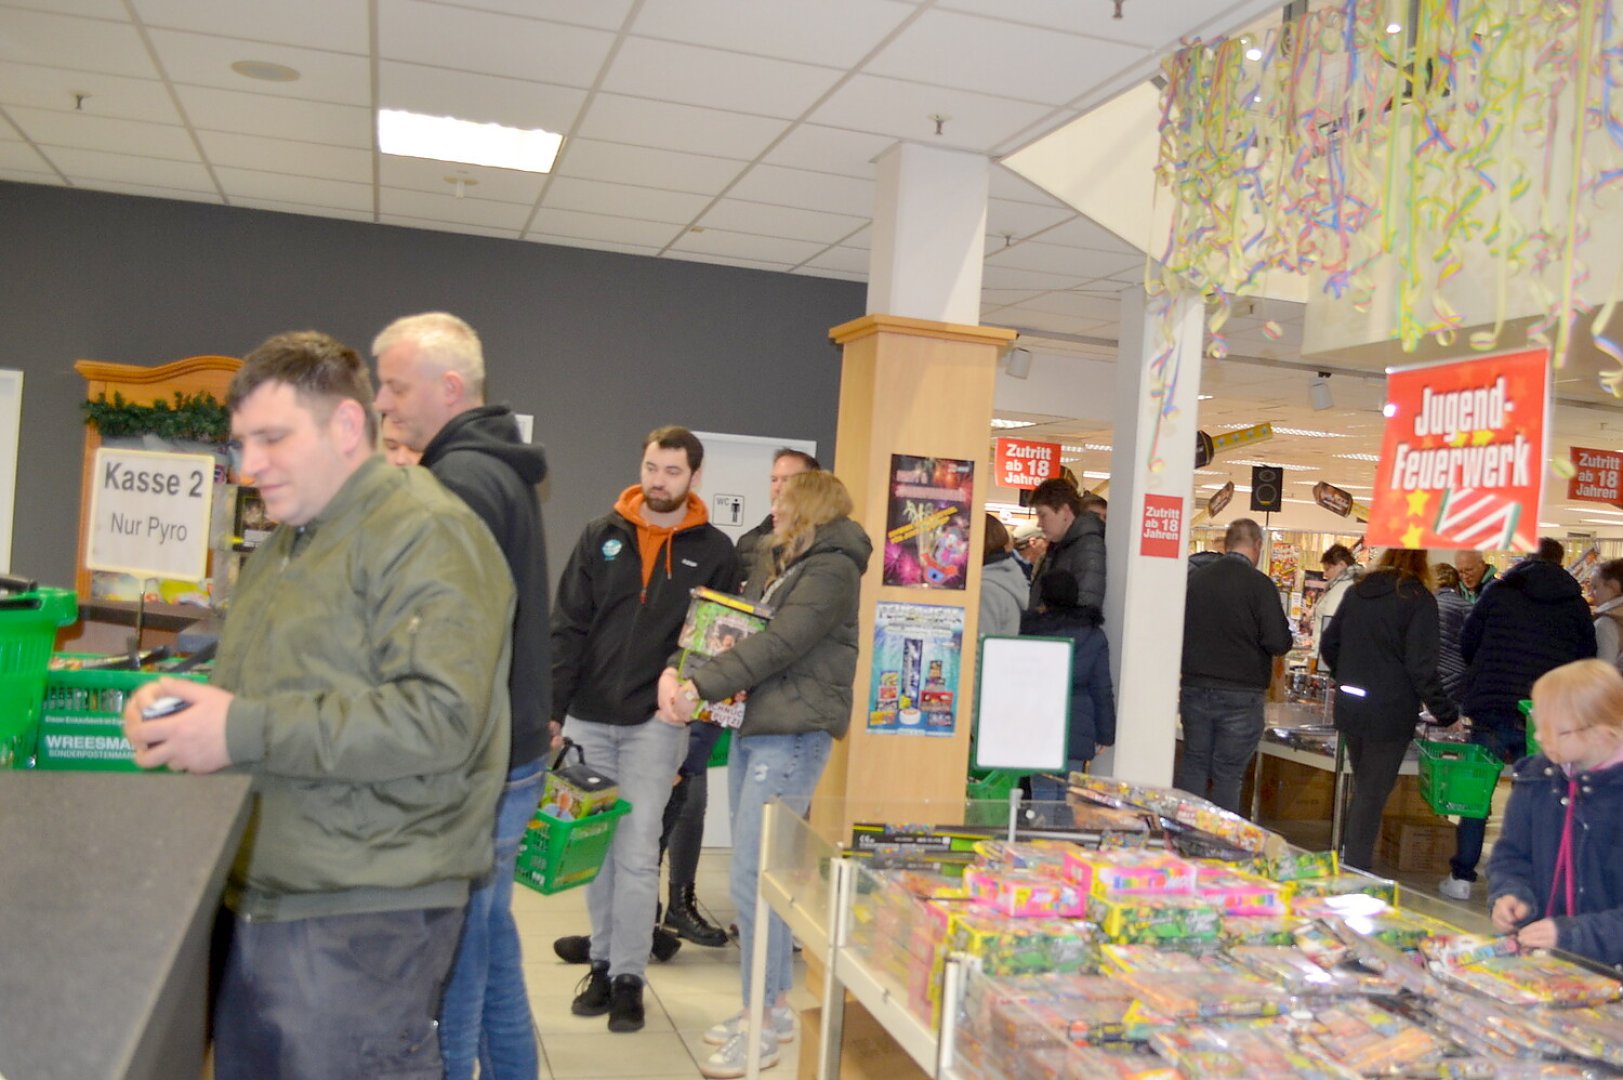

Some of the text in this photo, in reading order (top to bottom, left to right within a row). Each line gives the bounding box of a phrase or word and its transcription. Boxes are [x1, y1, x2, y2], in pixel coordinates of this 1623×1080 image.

[1414, 376, 1515, 442] Jugend-
[1006, 443, 1052, 460] Zutritt
[1005, 459, 1050, 477] ab 18
[1391, 434, 1530, 490] Feuerwerk
[1578, 453, 1620, 470] Zutritt
[104, 462, 204, 498] Kasse 2
[1578, 470, 1618, 489] ab 18
[1575, 483, 1618, 499] Jahren
[716, 497, 730, 506] WC
[1145, 506, 1180, 519] Zutritt
[110, 513, 188, 545] Nur Pyro
[1144, 518, 1179, 532] ab 18
[1143, 528, 1179, 541] Jahren
[45, 734, 135, 751] WREESMA
